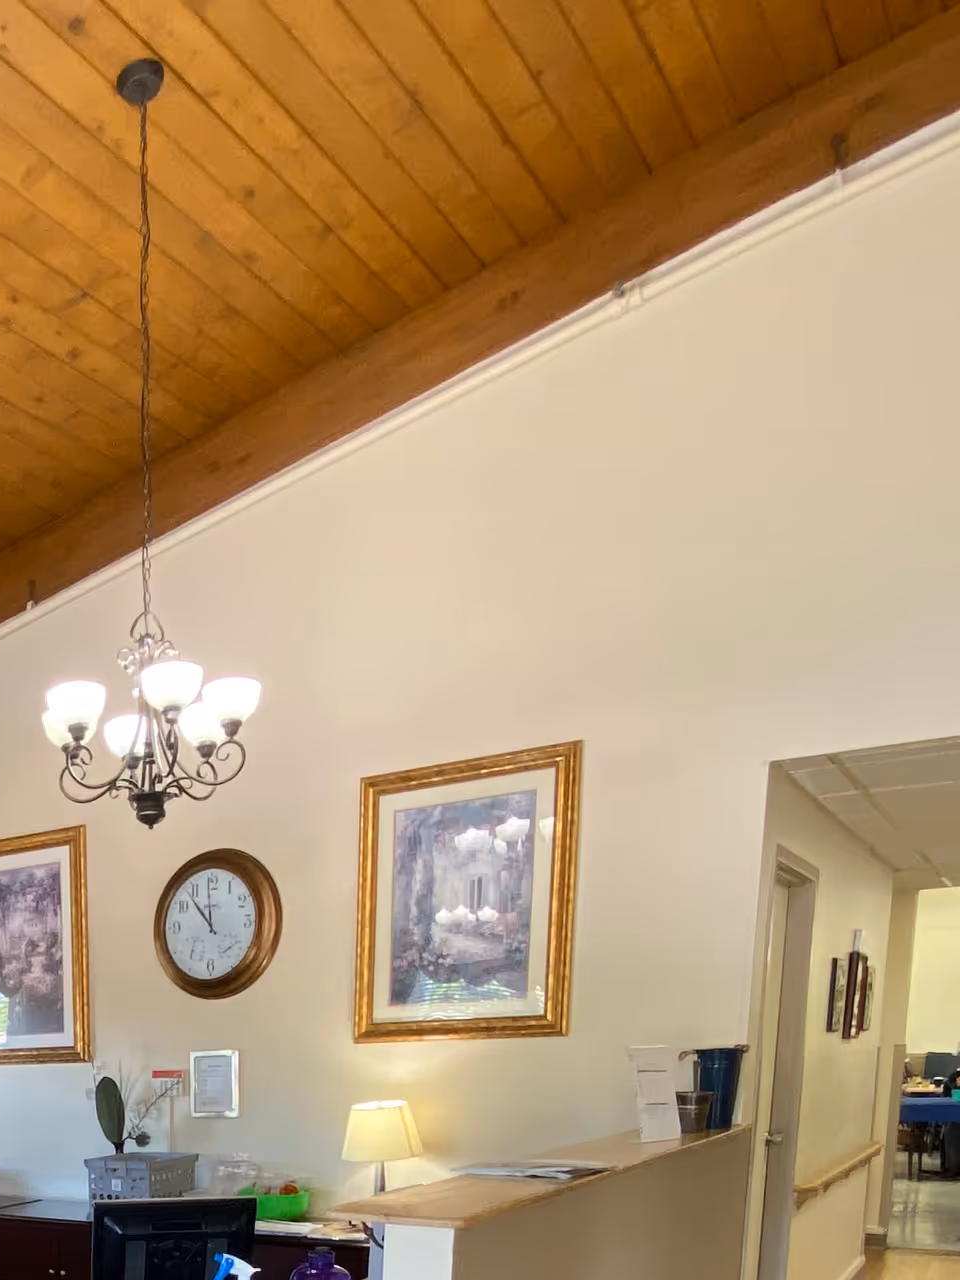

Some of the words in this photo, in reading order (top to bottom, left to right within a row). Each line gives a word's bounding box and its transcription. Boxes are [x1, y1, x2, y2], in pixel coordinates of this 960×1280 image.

[207, 874, 218, 891] 2
[192, 883, 199, 898] 11
[179, 900, 189, 914] 10
[238, 894, 246, 908] 2
[172, 921, 181, 934] 9
[206, 959, 215, 976] 6
